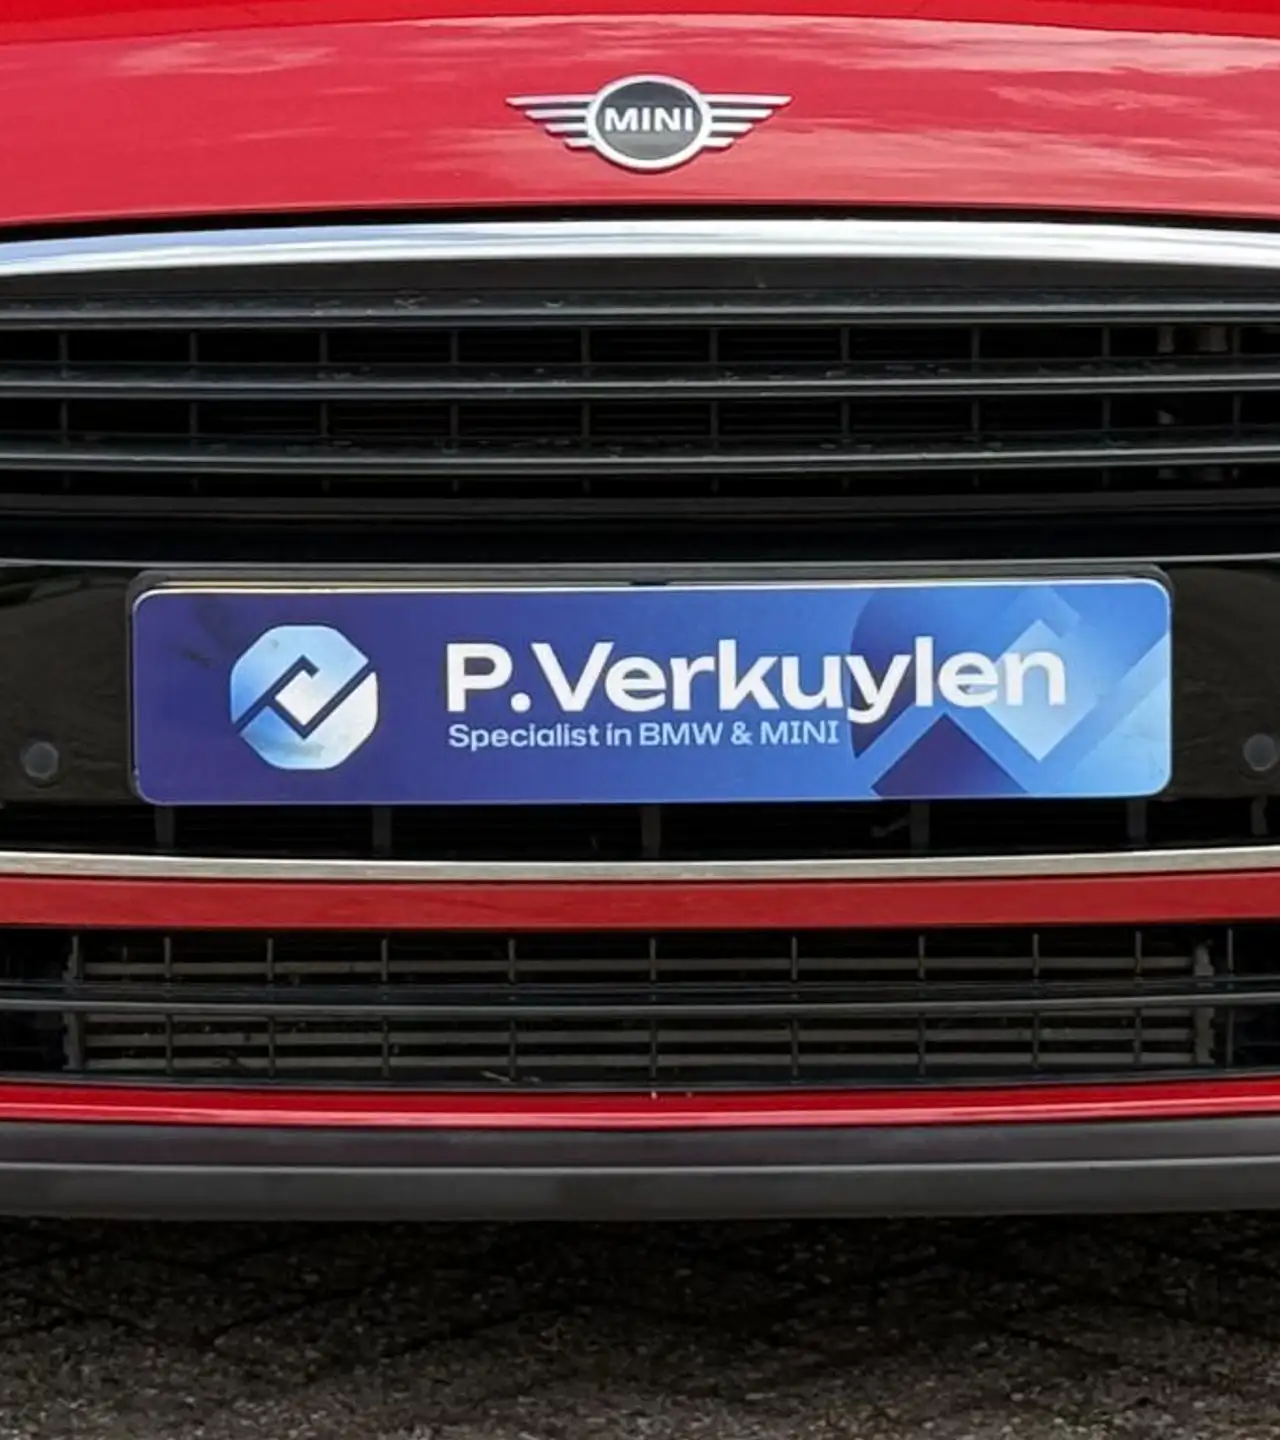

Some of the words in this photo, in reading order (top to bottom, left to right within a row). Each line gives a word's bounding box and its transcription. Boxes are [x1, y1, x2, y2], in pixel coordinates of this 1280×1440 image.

[603, 107, 694, 131] MINI
[446, 636, 1066, 723] P.Verkuylen
[448, 722, 600, 752] Specialist
[606, 721, 632, 747] in
[639, 721, 723, 746] BMW
[730, 721, 752, 746] &
[760, 720, 839, 745] MINI
